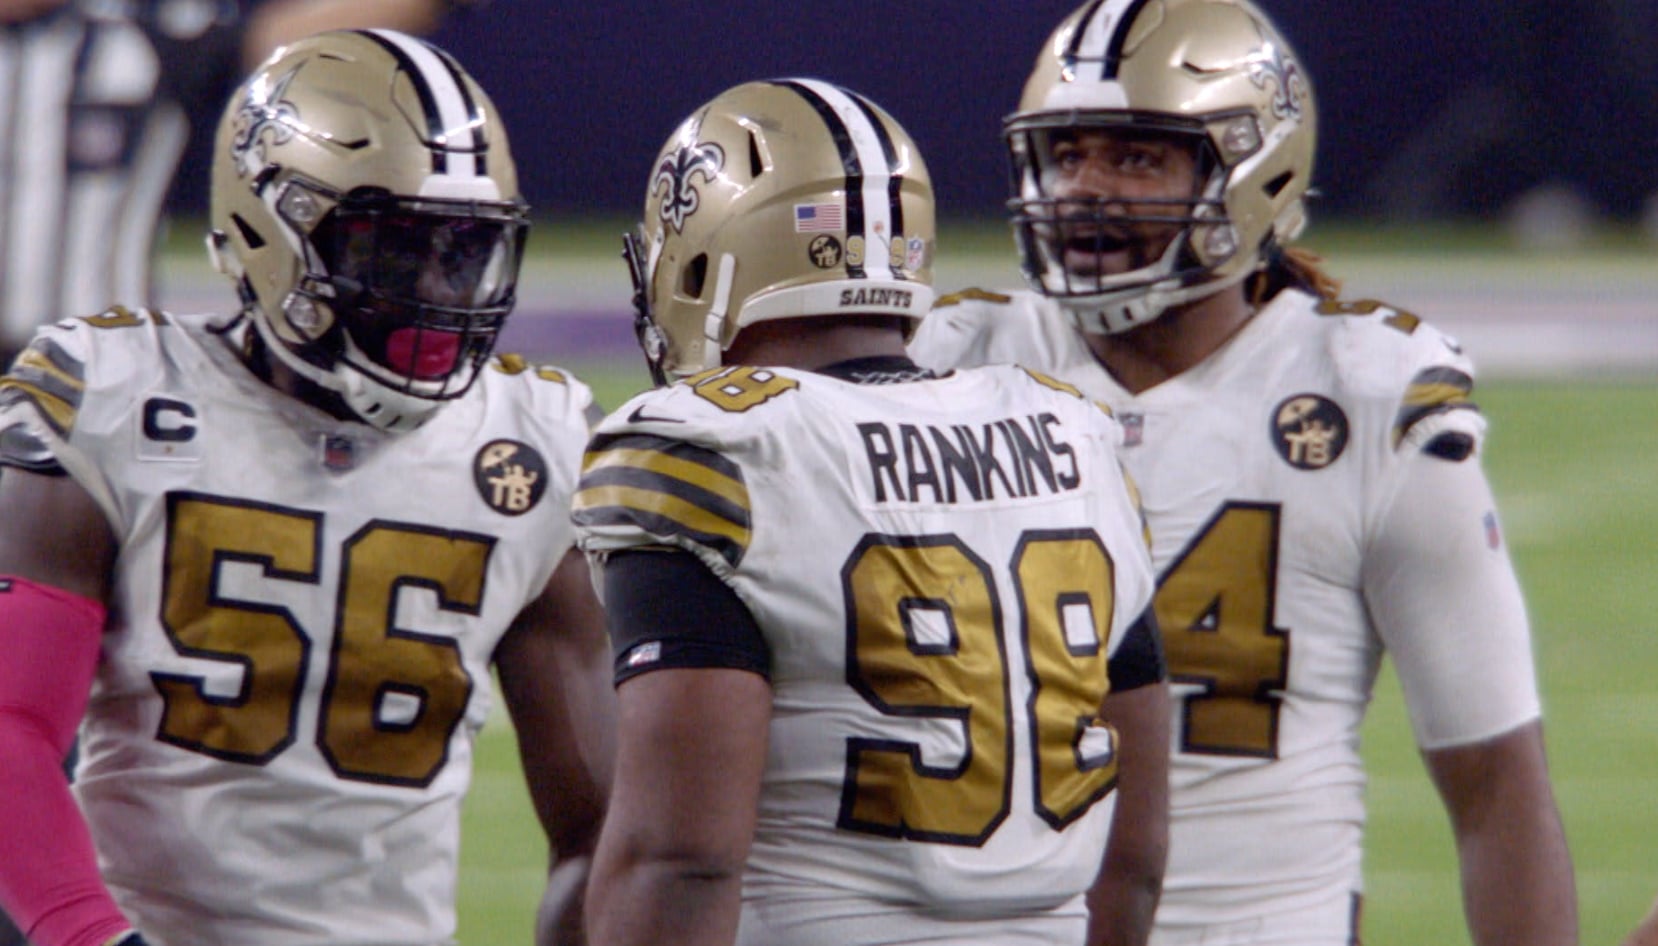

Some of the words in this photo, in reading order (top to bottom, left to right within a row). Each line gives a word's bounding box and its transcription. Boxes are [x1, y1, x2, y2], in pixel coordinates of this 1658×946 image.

[814, 254, 837, 267] TB
[839, 287, 912, 309] SAINTS
[143, 397, 197, 442] C
[857, 412, 1082, 504] RANKINS
[1284, 431, 1331, 464] TB
[488, 474, 532, 511] TB
[148, 490, 498, 789] 56
[836, 527, 1118, 848] 98
